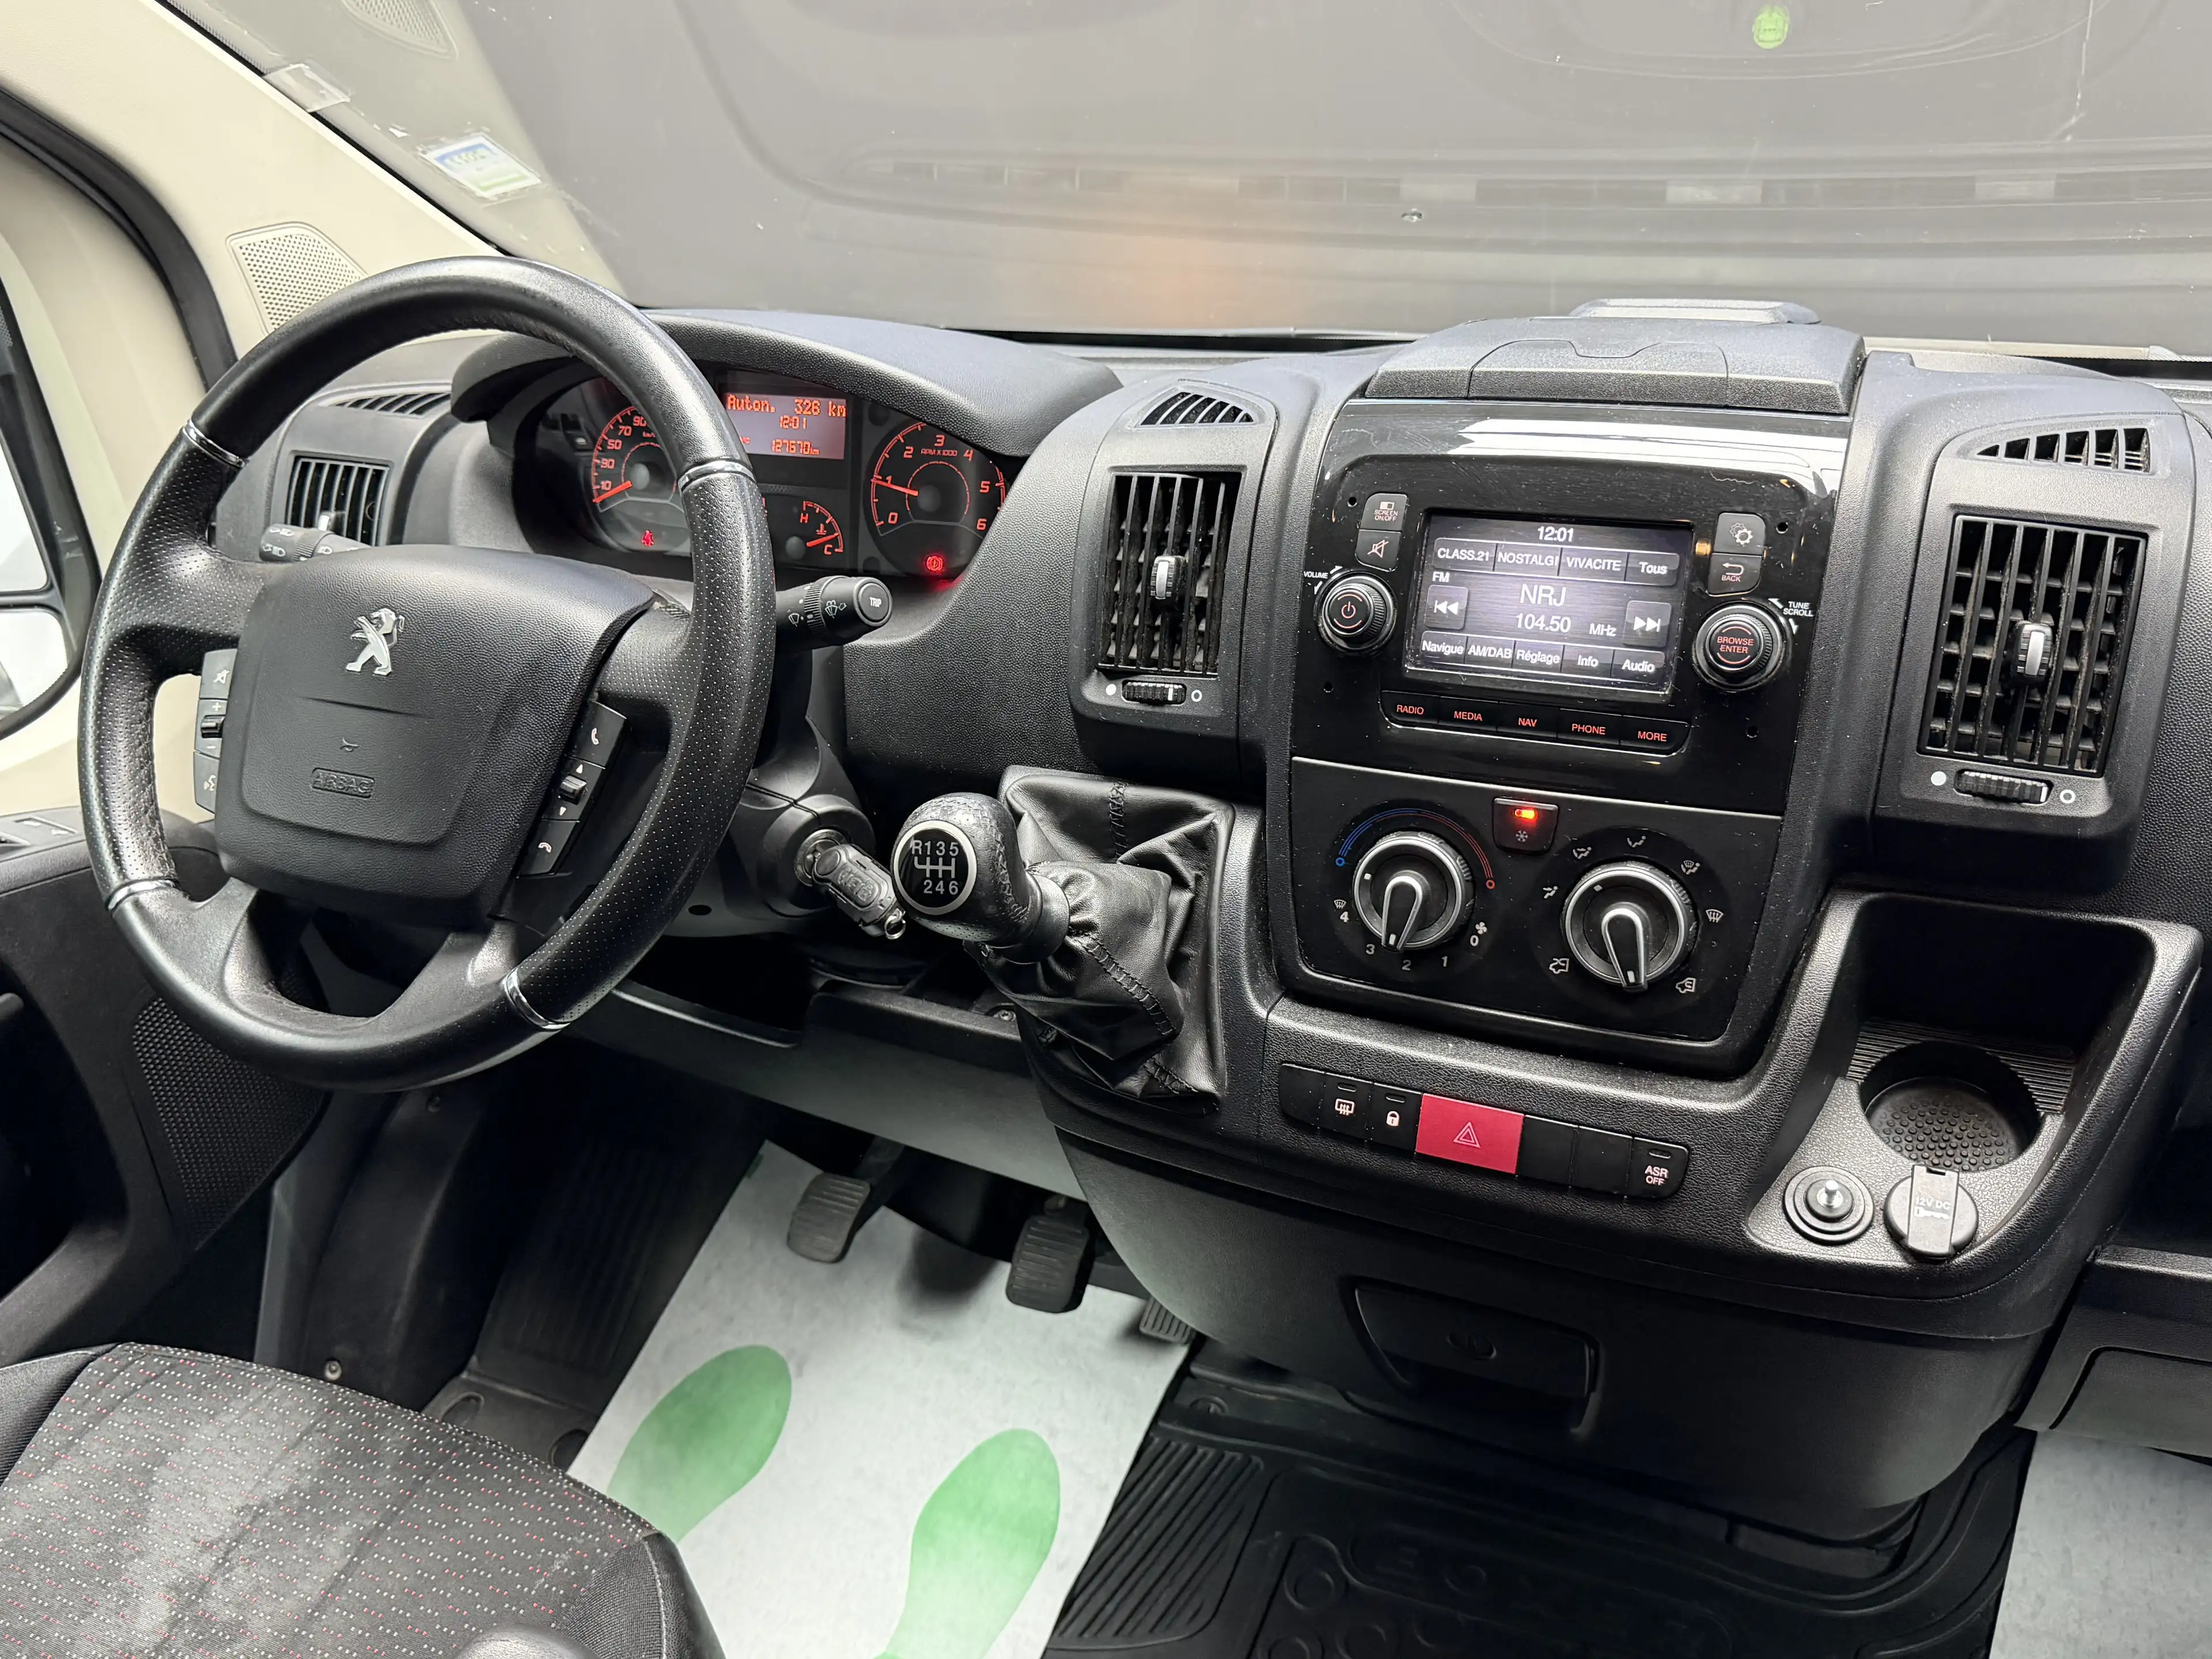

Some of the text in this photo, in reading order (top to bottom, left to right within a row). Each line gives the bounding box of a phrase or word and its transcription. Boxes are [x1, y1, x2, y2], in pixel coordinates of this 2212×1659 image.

[728, 395, 846, 417] Auton. 326 km
[618, 426, 632, 437] 70
[607, 440, 622, 450] 50
[934, 434, 945, 447] 3
[903, 446, 914, 459] 2
[963, 449, 974, 461] 4
[600, 480, 612, 490] 10
[980, 481, 990, 493] 5
[800, 513, 809, 524] H
[888, 512, 898, 524] 0
[976, 518, 987, 530] 6
[1537, 525, 1574, 542] 12:01
[824, 544, 833, 555] C
[1437, 547, 1489, 562] CLASS.21
[1497, 552, 1559, 567] NOSTALGI
[1566, 556, 1622, 571] VIVACITE
[1639, 561, 1668, 575] Tous
[1304, 570, 1328, 579] VOLUME
[1432, 572, 1450, 583] FM
[1520, 584, 1566, 607] NRJ
[869, 597, 881, 608] TRIP
[1788, 601, 1811, 610] TUNE
[1783, 608, 1814, 617] SCROLL
[1516, 613, 1616, 637] 104.50 MHz
[1717, 636, 1754, 646] BROWSE
[1422, 640, 1464, 656] Navigue
[1468, 644, 1513, 658] AM/DAB
[1719, 645, 1748, 654] ENTER
[1516, 648, 1560, 665] Réglage
[1578, 655, 1599, 668] Info
[1622, 659, 1655, 673] Audio
[1396, 704, 1425, 715] RADIO
[1453, 711, 1483, 722] MEDIA
[1518, 717, 1537, 727] NAV
[1571, 723, 1606, 736] PHONE
[1637, 730, 1667, 743] MORE
[1340, 911, 1349, 923] 4
[1470, 935, 1479, 946] 0
[1366, 944, 1375, 955] 3
[1402, 960, 1411, 971] 2
[1442, 956, 1448, 967] 1
[1645, 1165, 1669, 1178] ASR
[1646, 1175, 1665, 1185] OFF
[1915, 1197, 1951, 1210] 12V DC
